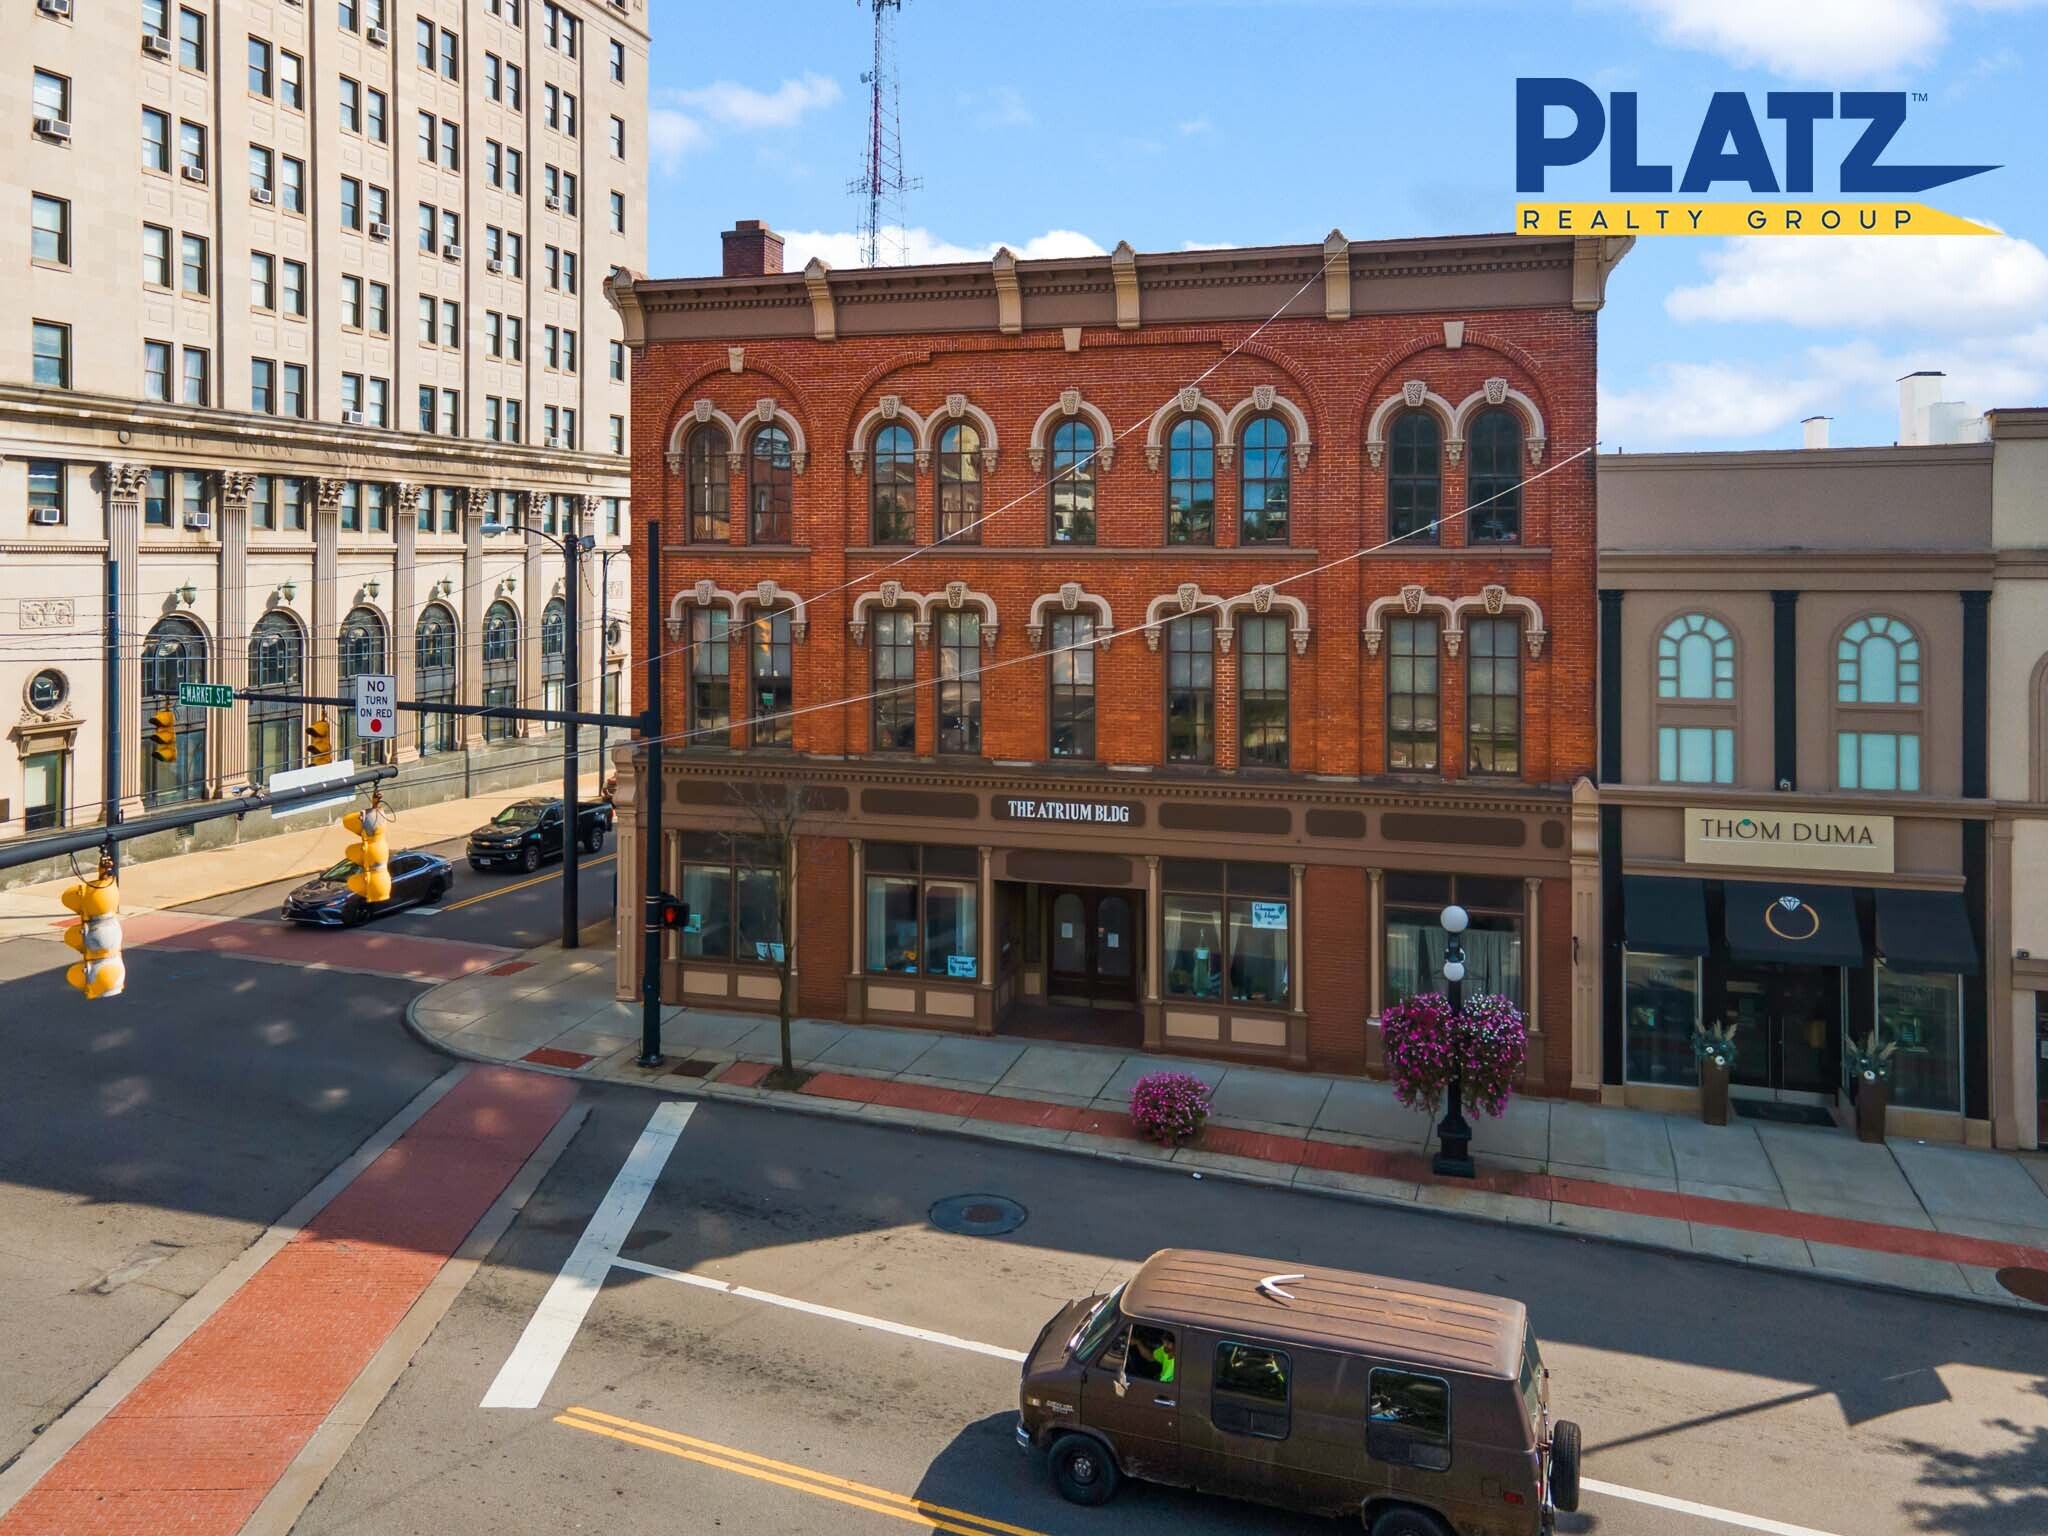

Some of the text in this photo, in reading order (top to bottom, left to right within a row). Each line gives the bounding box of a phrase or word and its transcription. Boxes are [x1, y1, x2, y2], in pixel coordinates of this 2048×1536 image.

[234, 439, 294, 457] UNION
[186, 686, 212, 704] MARKET
[367, 680, 385, 692] NO
[364, 695, 388, 705] TURN
[360, 708, 392, 718] ON RED
[1008, 800, 1129, 822] THE ATRIUM BLDG
[1701, 818, 1873, 844] THOM DUMA
